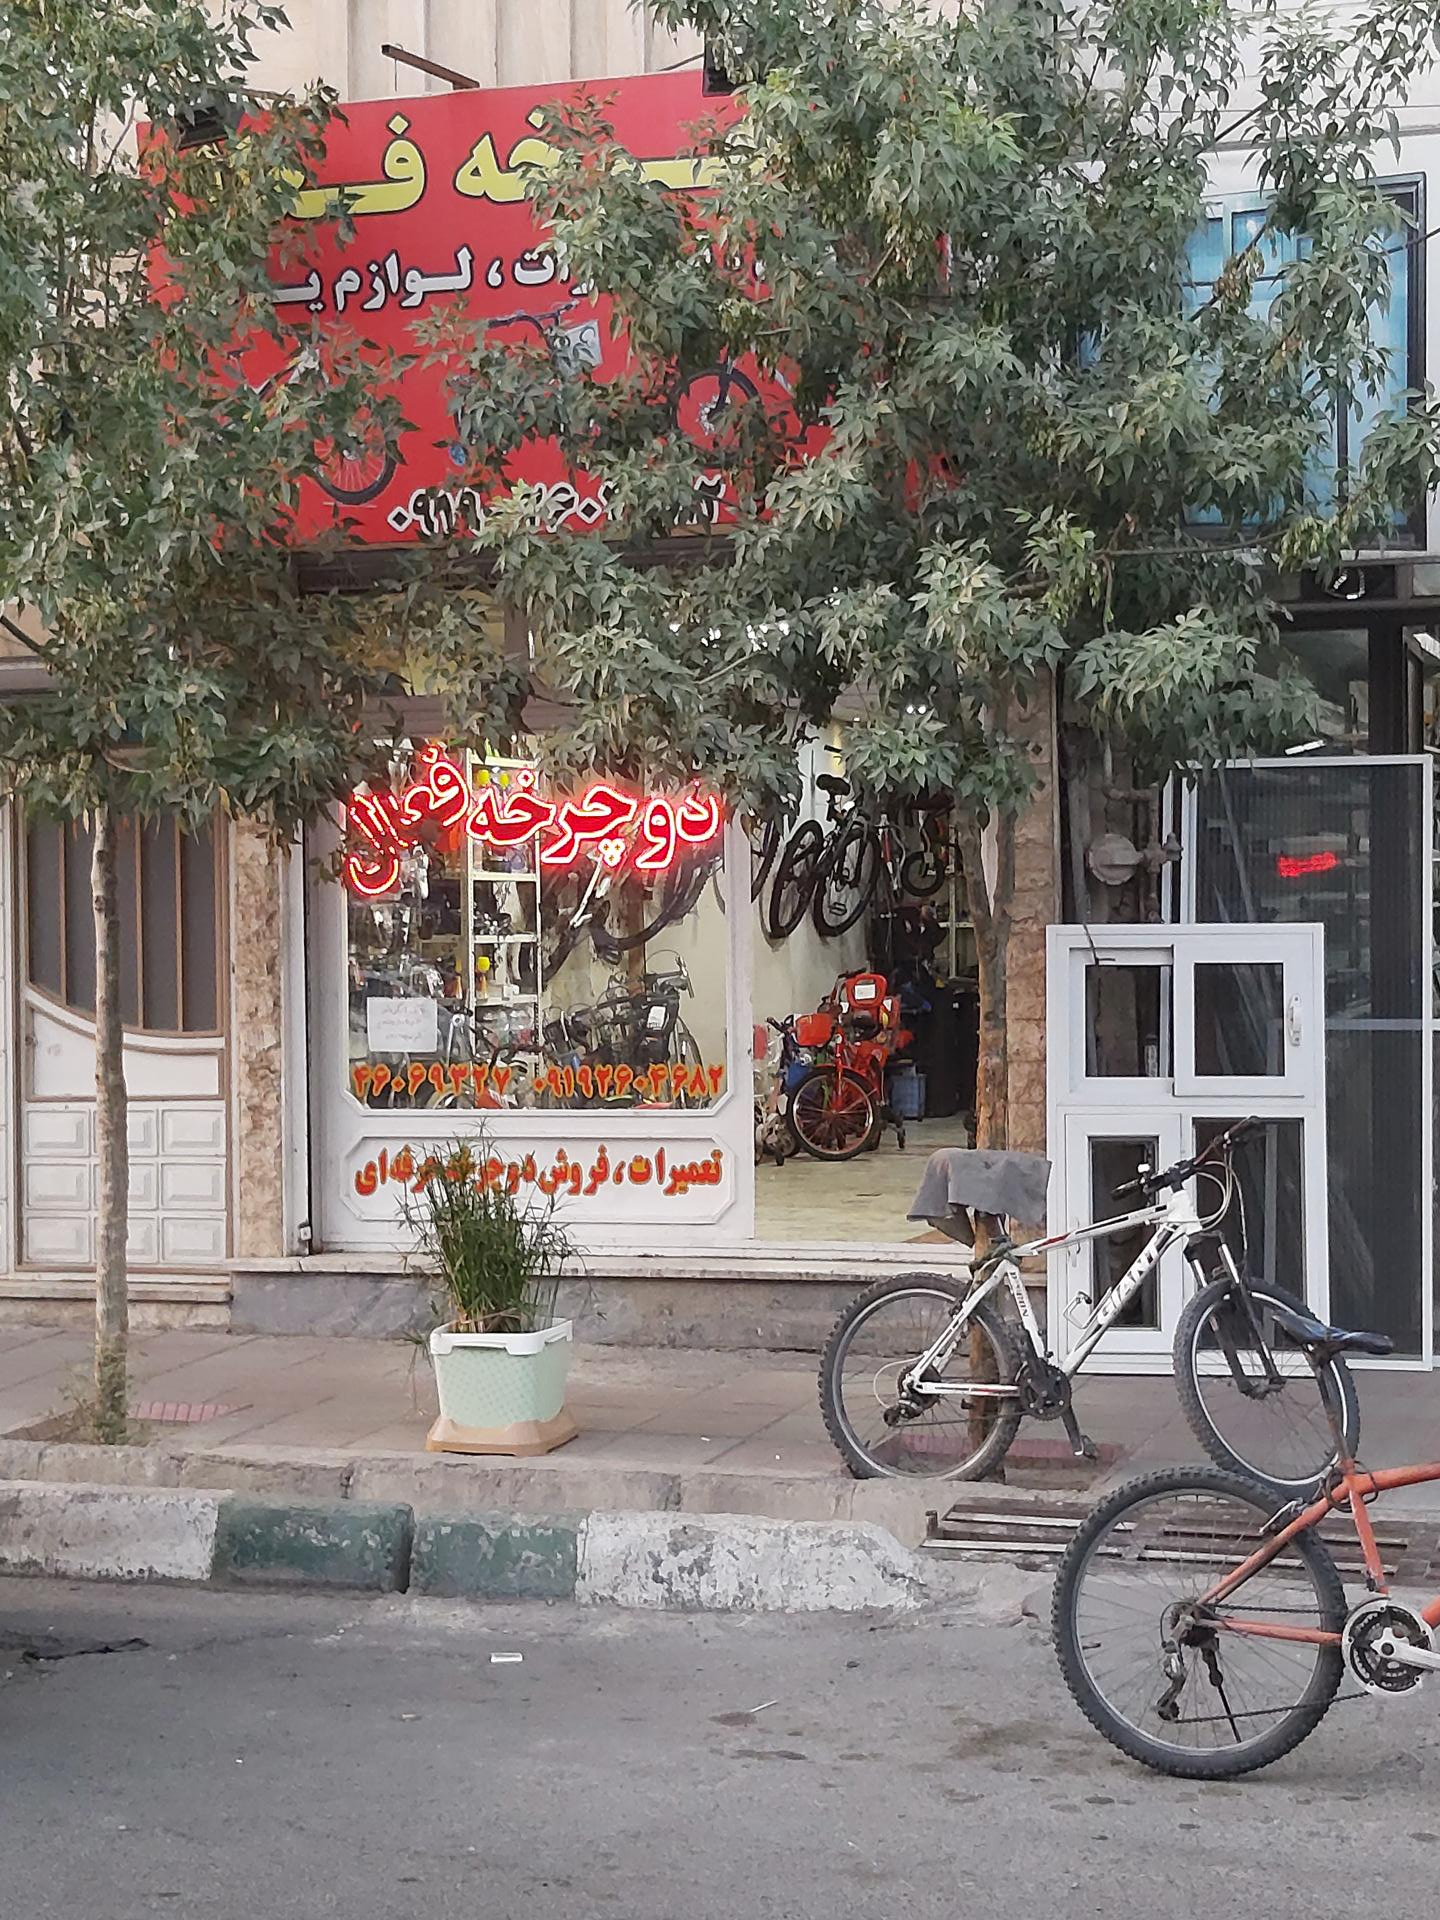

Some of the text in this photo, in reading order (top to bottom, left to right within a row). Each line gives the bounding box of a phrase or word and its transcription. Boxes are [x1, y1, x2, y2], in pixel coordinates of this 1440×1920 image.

[335, 246, 473, 311] لوازم
[353, 1063, 723, 1098] ۰۹۱۹۲۶۰۴۶۸۲ ۴۶۰۶۹۳۲۷
[538, 1143, 611, 1196] فروش
[1097, 1242, 1160, 1325] GIANT
